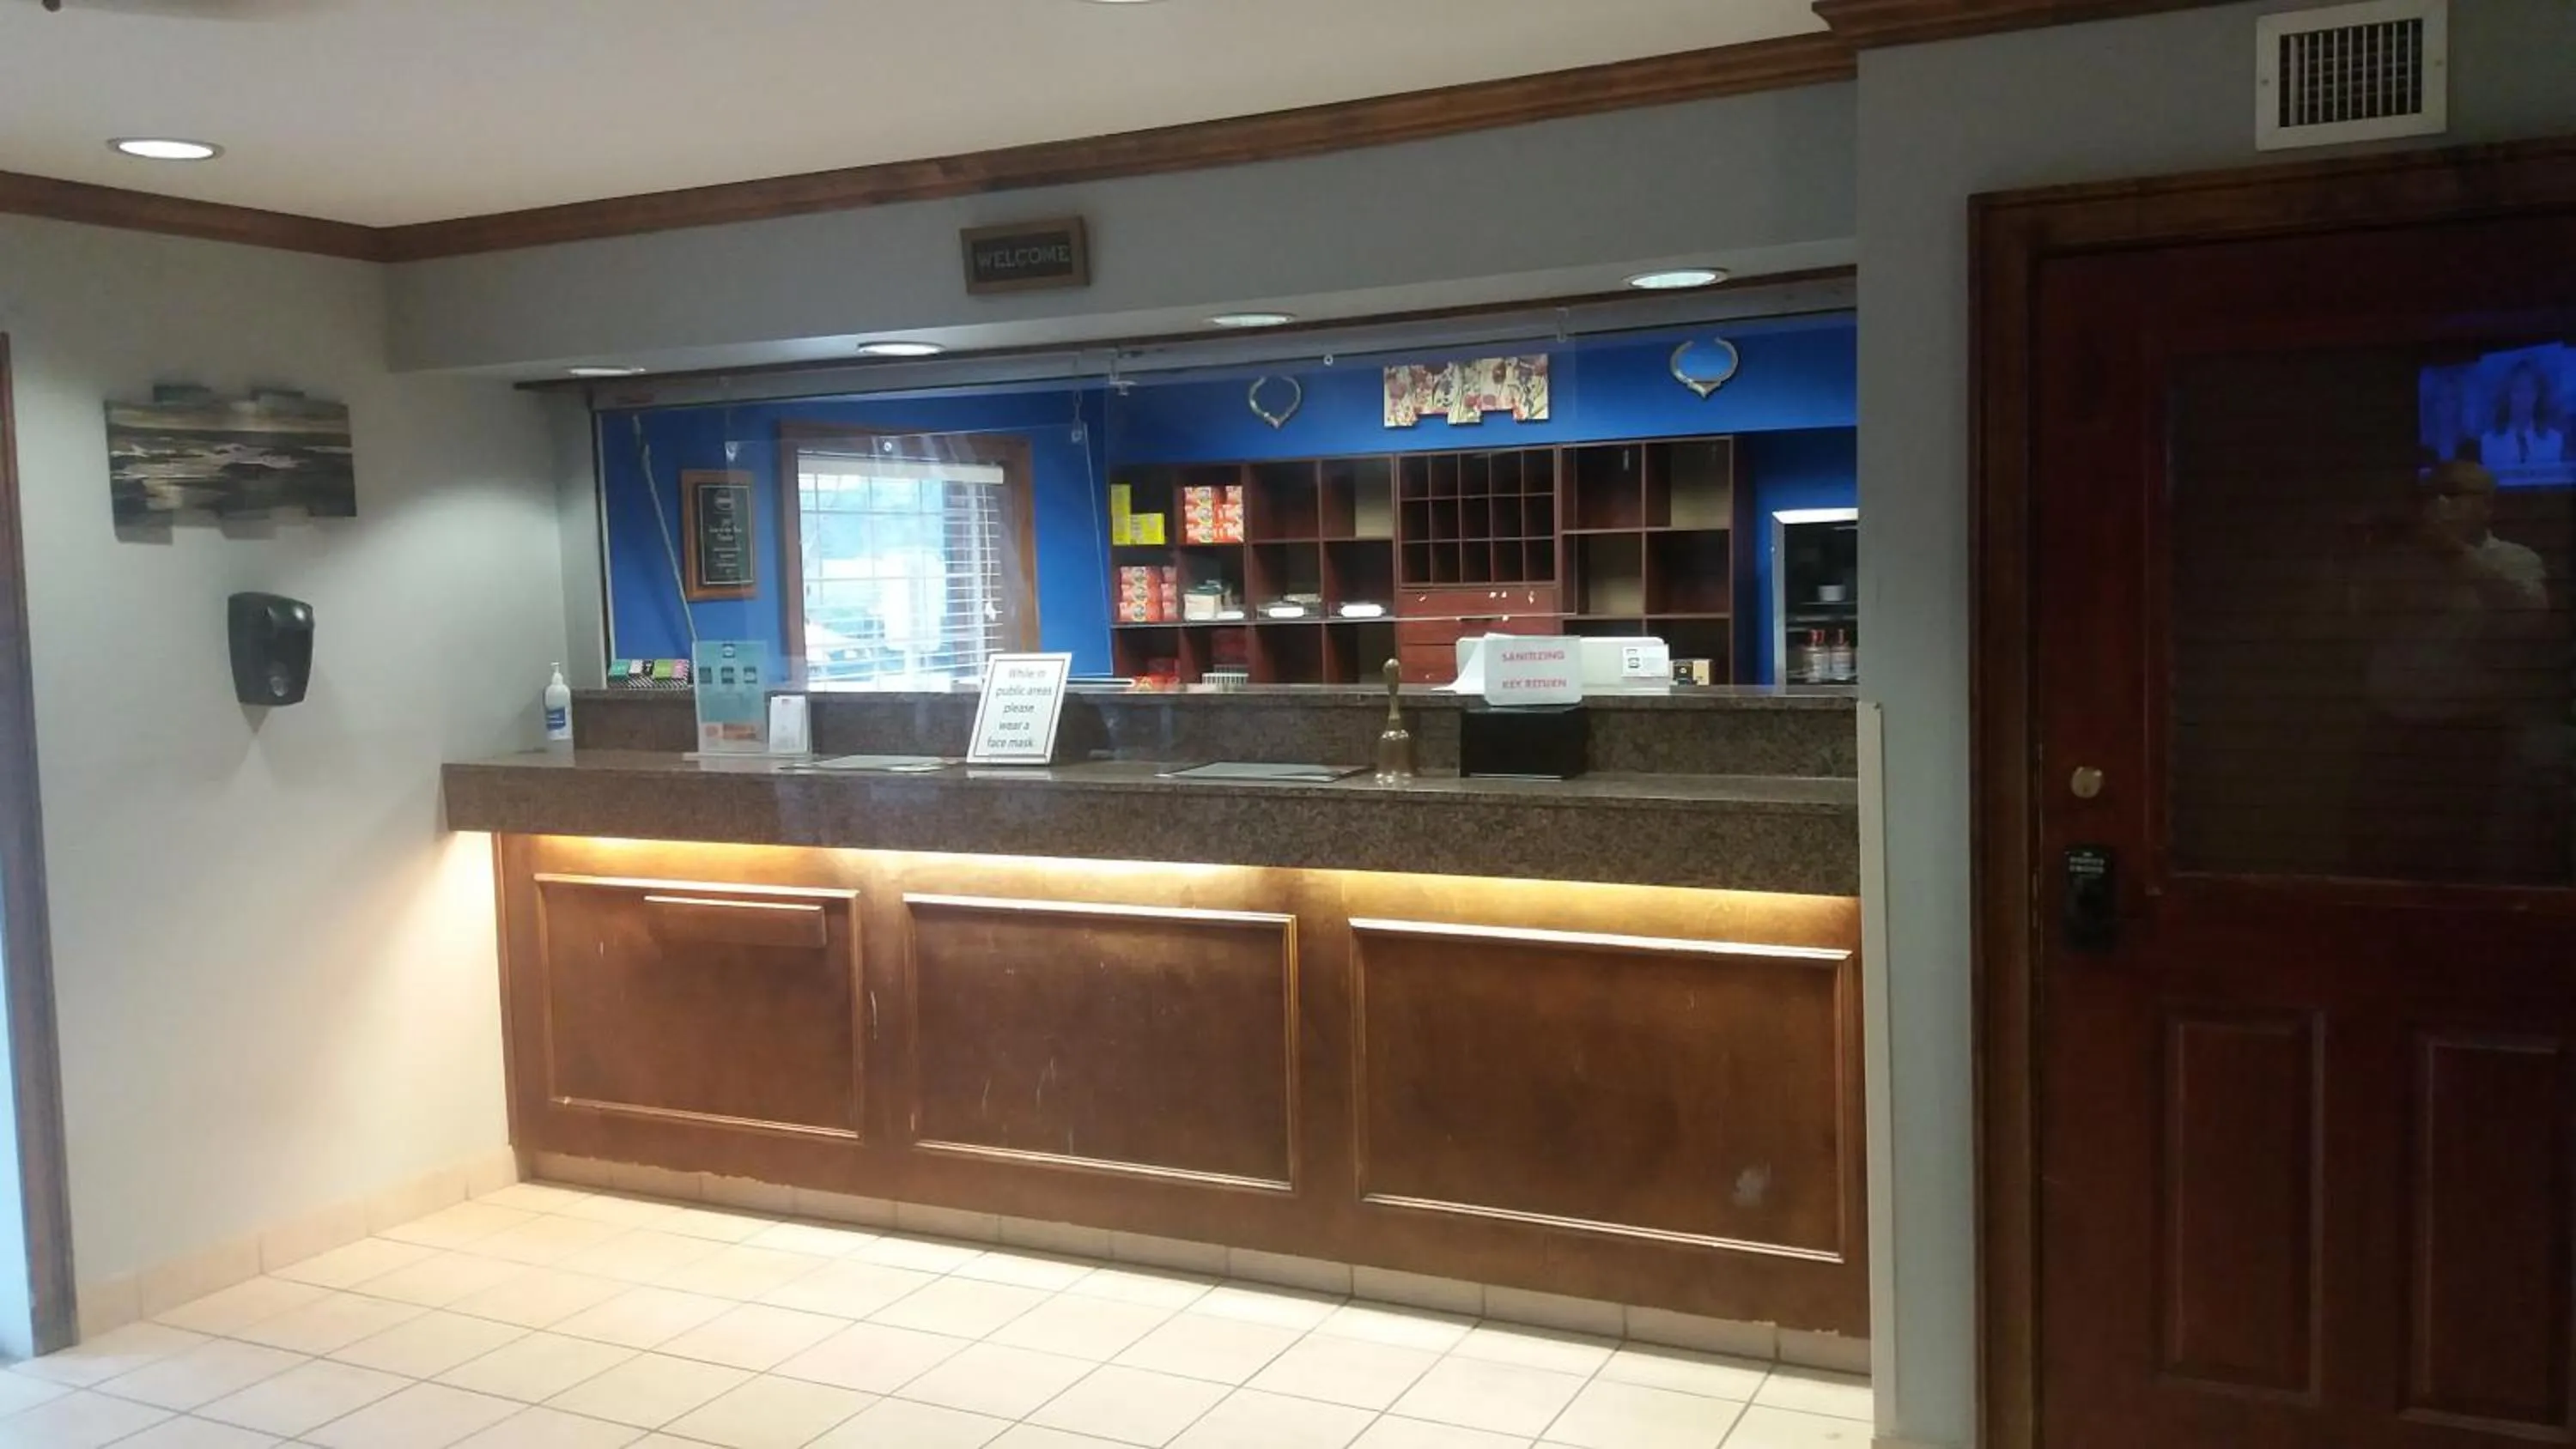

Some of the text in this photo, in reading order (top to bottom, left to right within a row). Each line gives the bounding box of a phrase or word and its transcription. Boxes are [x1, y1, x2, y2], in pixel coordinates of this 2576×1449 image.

[976, 244, 1071, 269] WELCOME
[1502, 678, 1567, 688] KEY RETURN
[996, 684, 1052, 700] public areas
[1003, 702, 1035, 718] please
[999, 721, 1030, 731] wear a
[987, 736, 1006, 748] face
